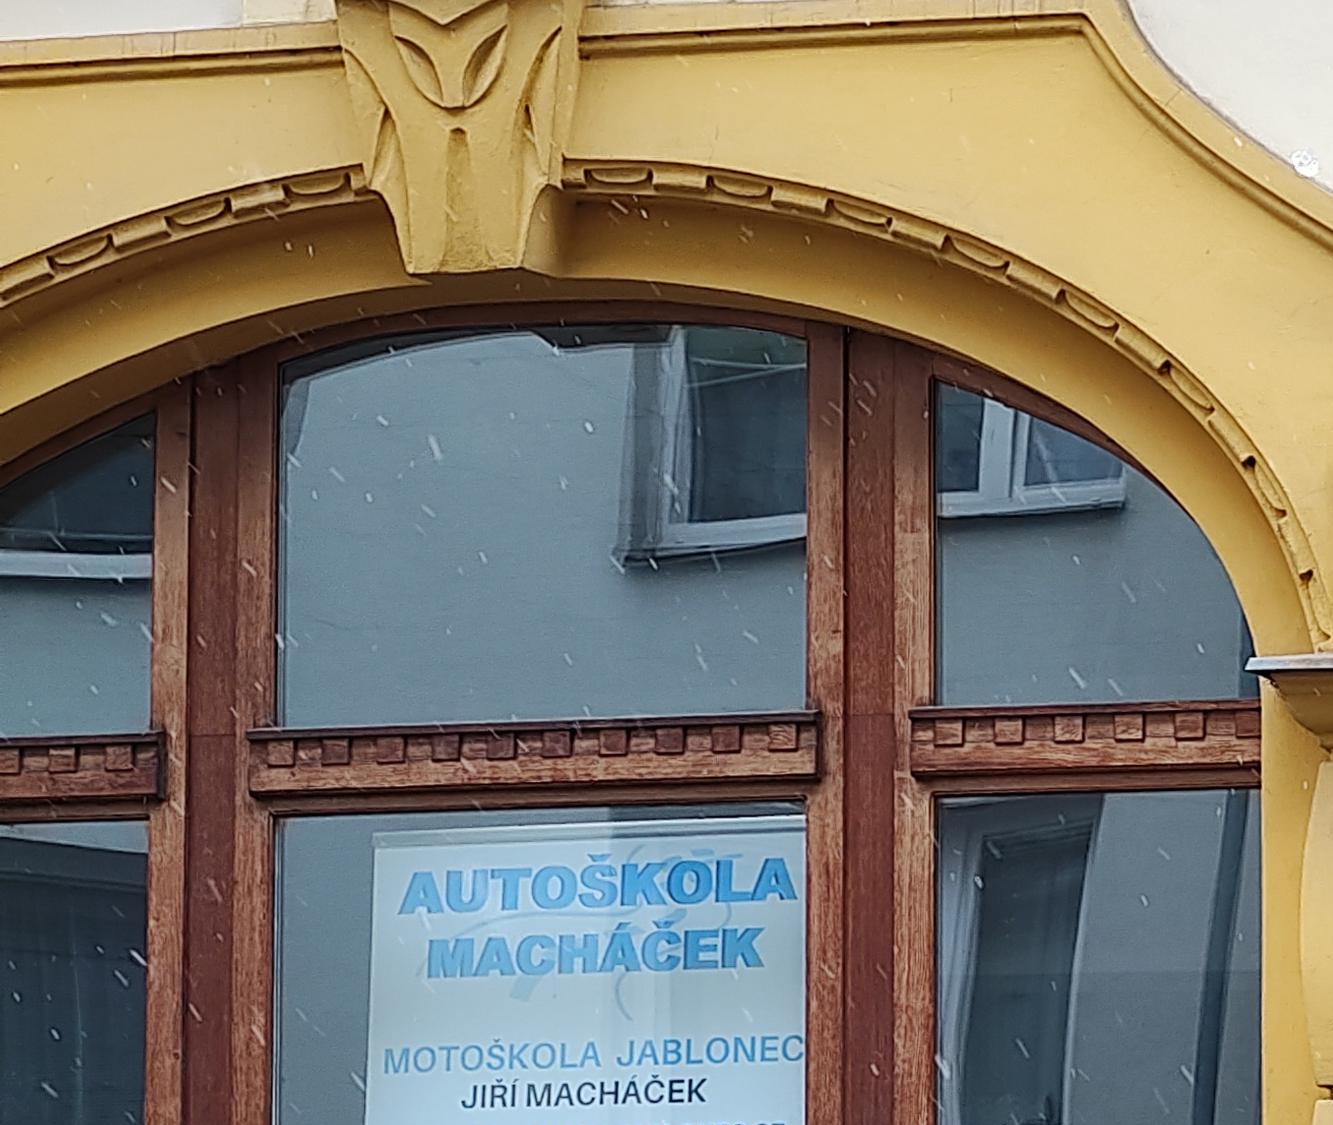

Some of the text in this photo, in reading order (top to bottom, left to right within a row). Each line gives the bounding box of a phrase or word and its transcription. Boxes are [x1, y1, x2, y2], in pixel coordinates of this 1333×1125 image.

[398, 853, 798, 915] AUTOŠKOLA
[427, 920, 765, 978] MACHÁČEK
[384, 1034, 804, 1074] MOTOŠKOLA JABLONEC
[461, 1075, 707, 1109] JIŘÍ MACHÁČEK
